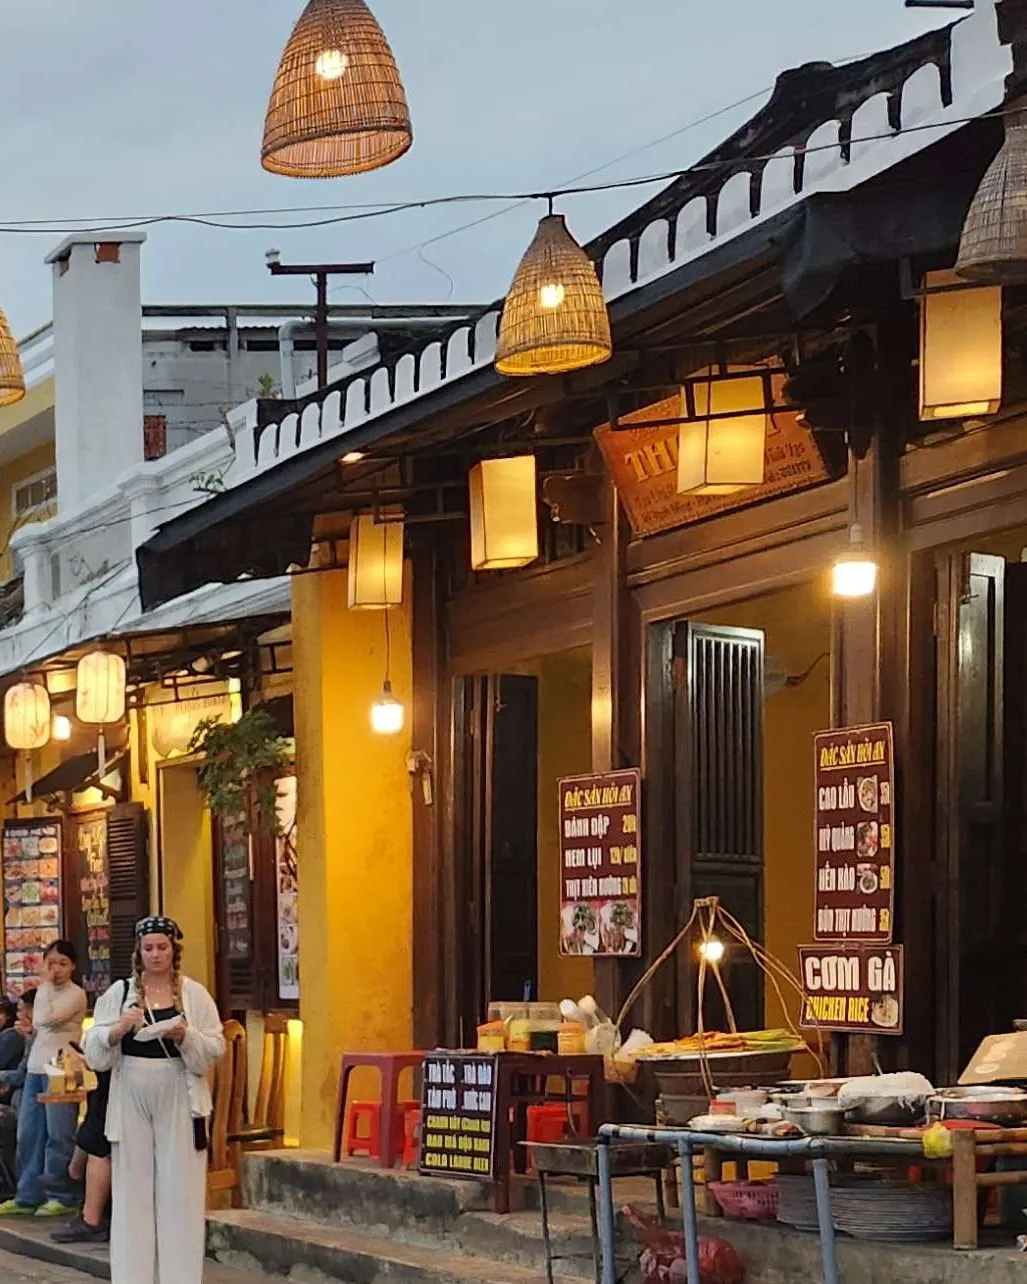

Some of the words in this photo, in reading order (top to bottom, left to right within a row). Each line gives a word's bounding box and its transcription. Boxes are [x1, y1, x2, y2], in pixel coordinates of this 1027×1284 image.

[819, 786, 837, 811] CAO
[838, 777, 854, 809] LẦU
[565, 816, 589, 838] BÁNH
[591, 814, 610, 839] ĐẬP
[565, 849, 585, 867] NEM
[588, 847, 602, 870] LỤI
[819, 860, 836, 892] HẾN
[805, 955, 860, 991] CƠM
[868, 950, 896, 992] GÀ
[806, 996, 847, 1022] CHICKEN
[848, 997, 870, 1023] RICE
